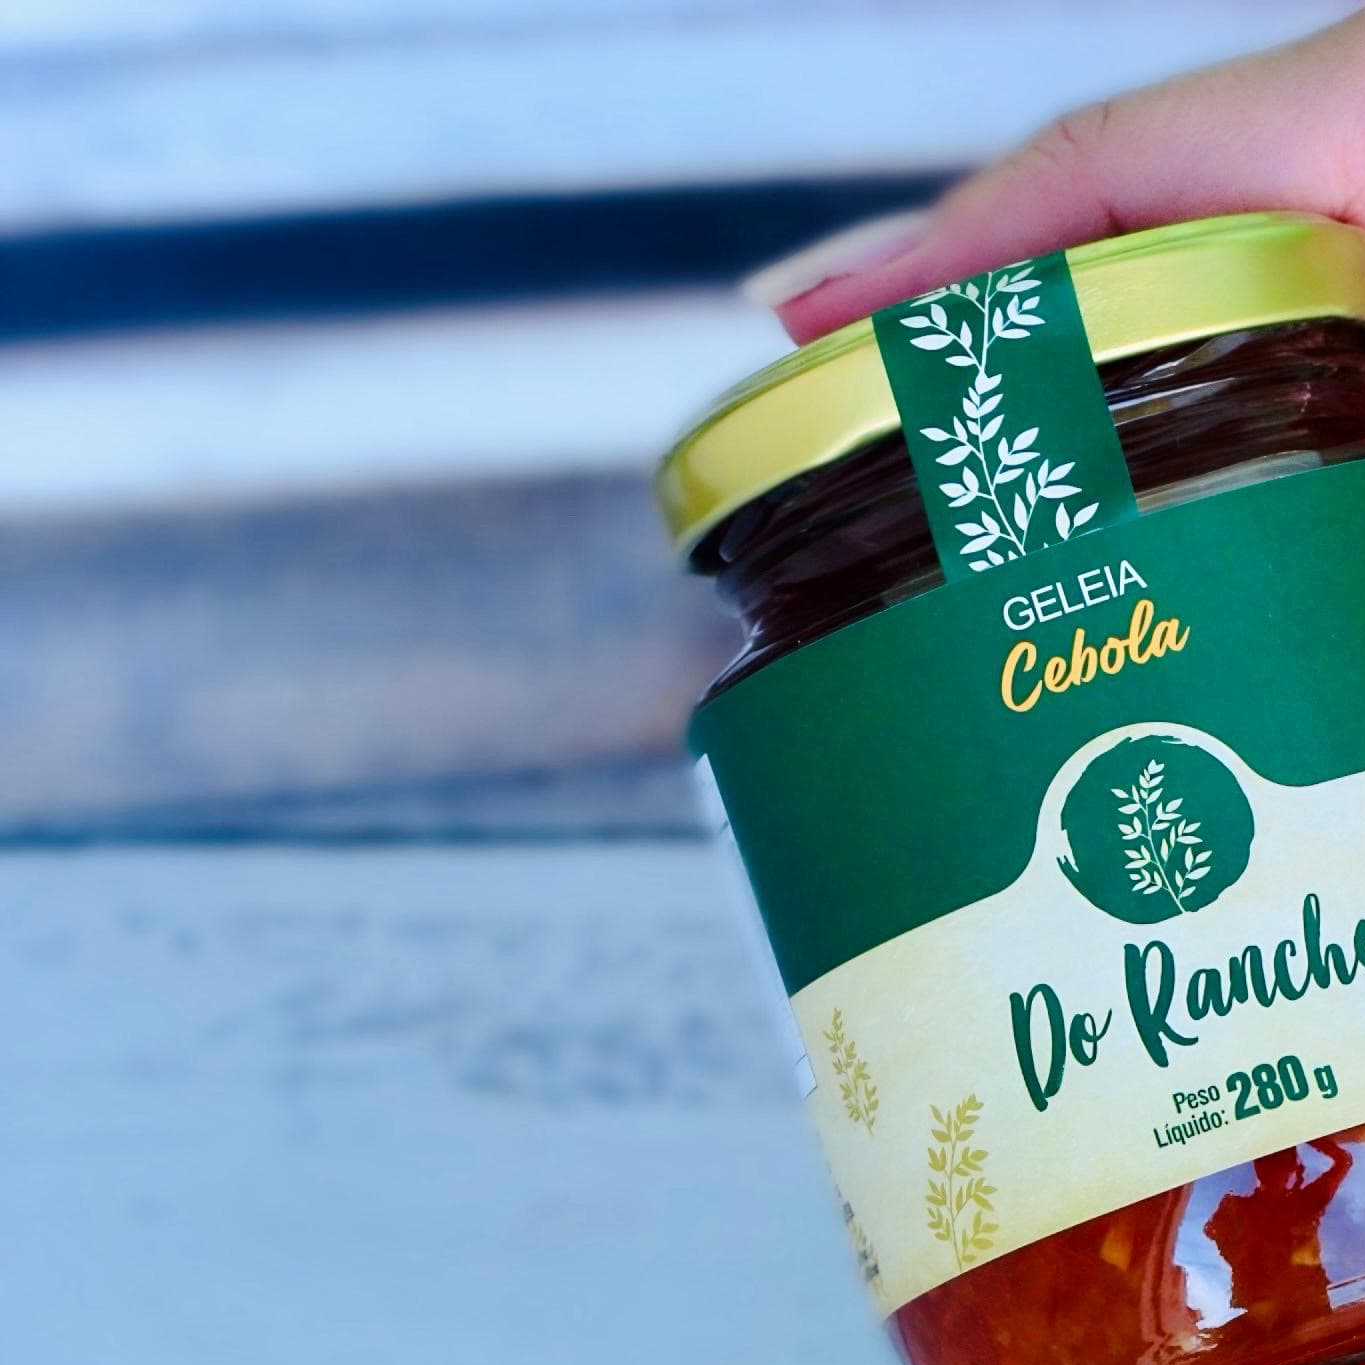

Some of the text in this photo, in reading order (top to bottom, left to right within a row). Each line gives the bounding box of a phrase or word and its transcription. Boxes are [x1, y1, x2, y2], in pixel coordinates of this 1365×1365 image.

[1003, 560, 1148, 631] GELEIA
[1001, 599, 1191, 713] Cebola
[1009, 983, 1112, 1112] Do
[1172, 1085, 1221, 1114] Peso
[1226, 1055, 1339, 1121] 280 g
[1153, 1109, 1230, 1149] Líquido:
